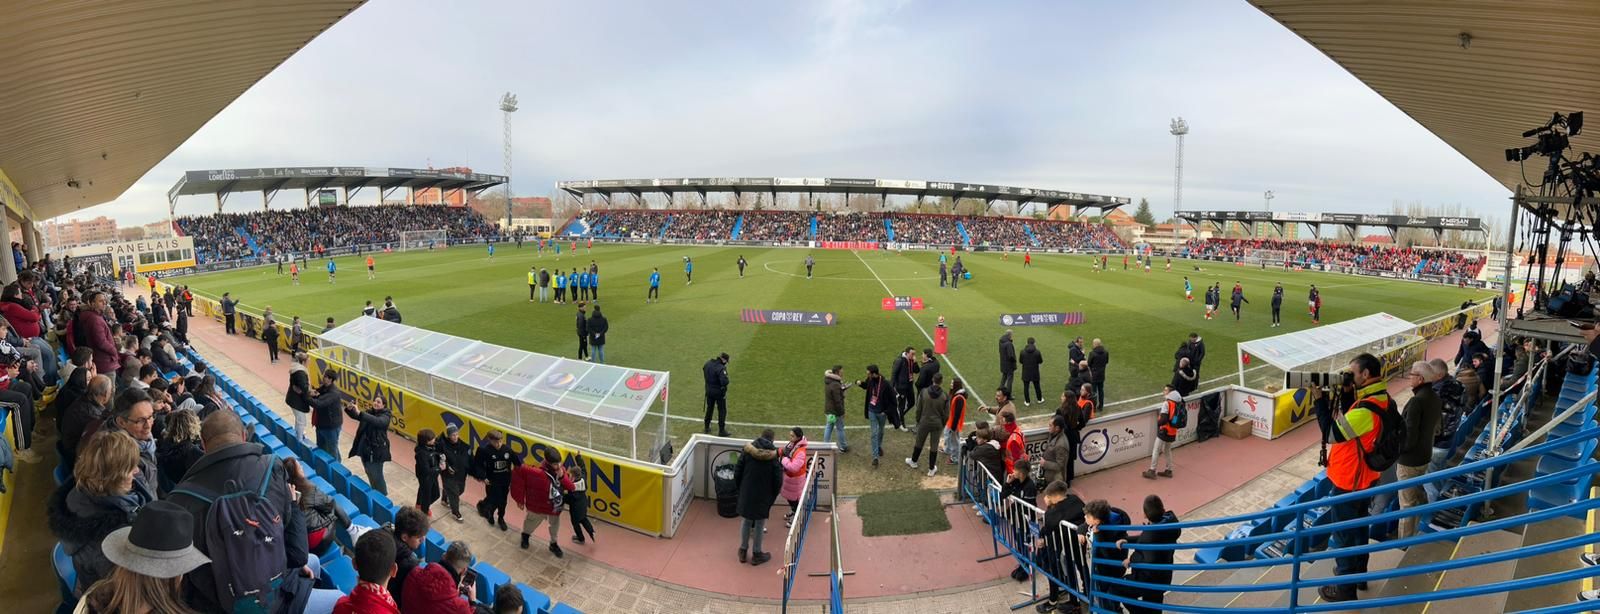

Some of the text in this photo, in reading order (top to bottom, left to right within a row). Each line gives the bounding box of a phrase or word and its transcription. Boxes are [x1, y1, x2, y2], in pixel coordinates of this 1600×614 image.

[106, 240, 179, 253] PANELAIS
[772, 312, 803, 321] COPA REY
[479, 364, 535, 379] PANELAIS
[574, 385, 646, 401] PANELAIS
